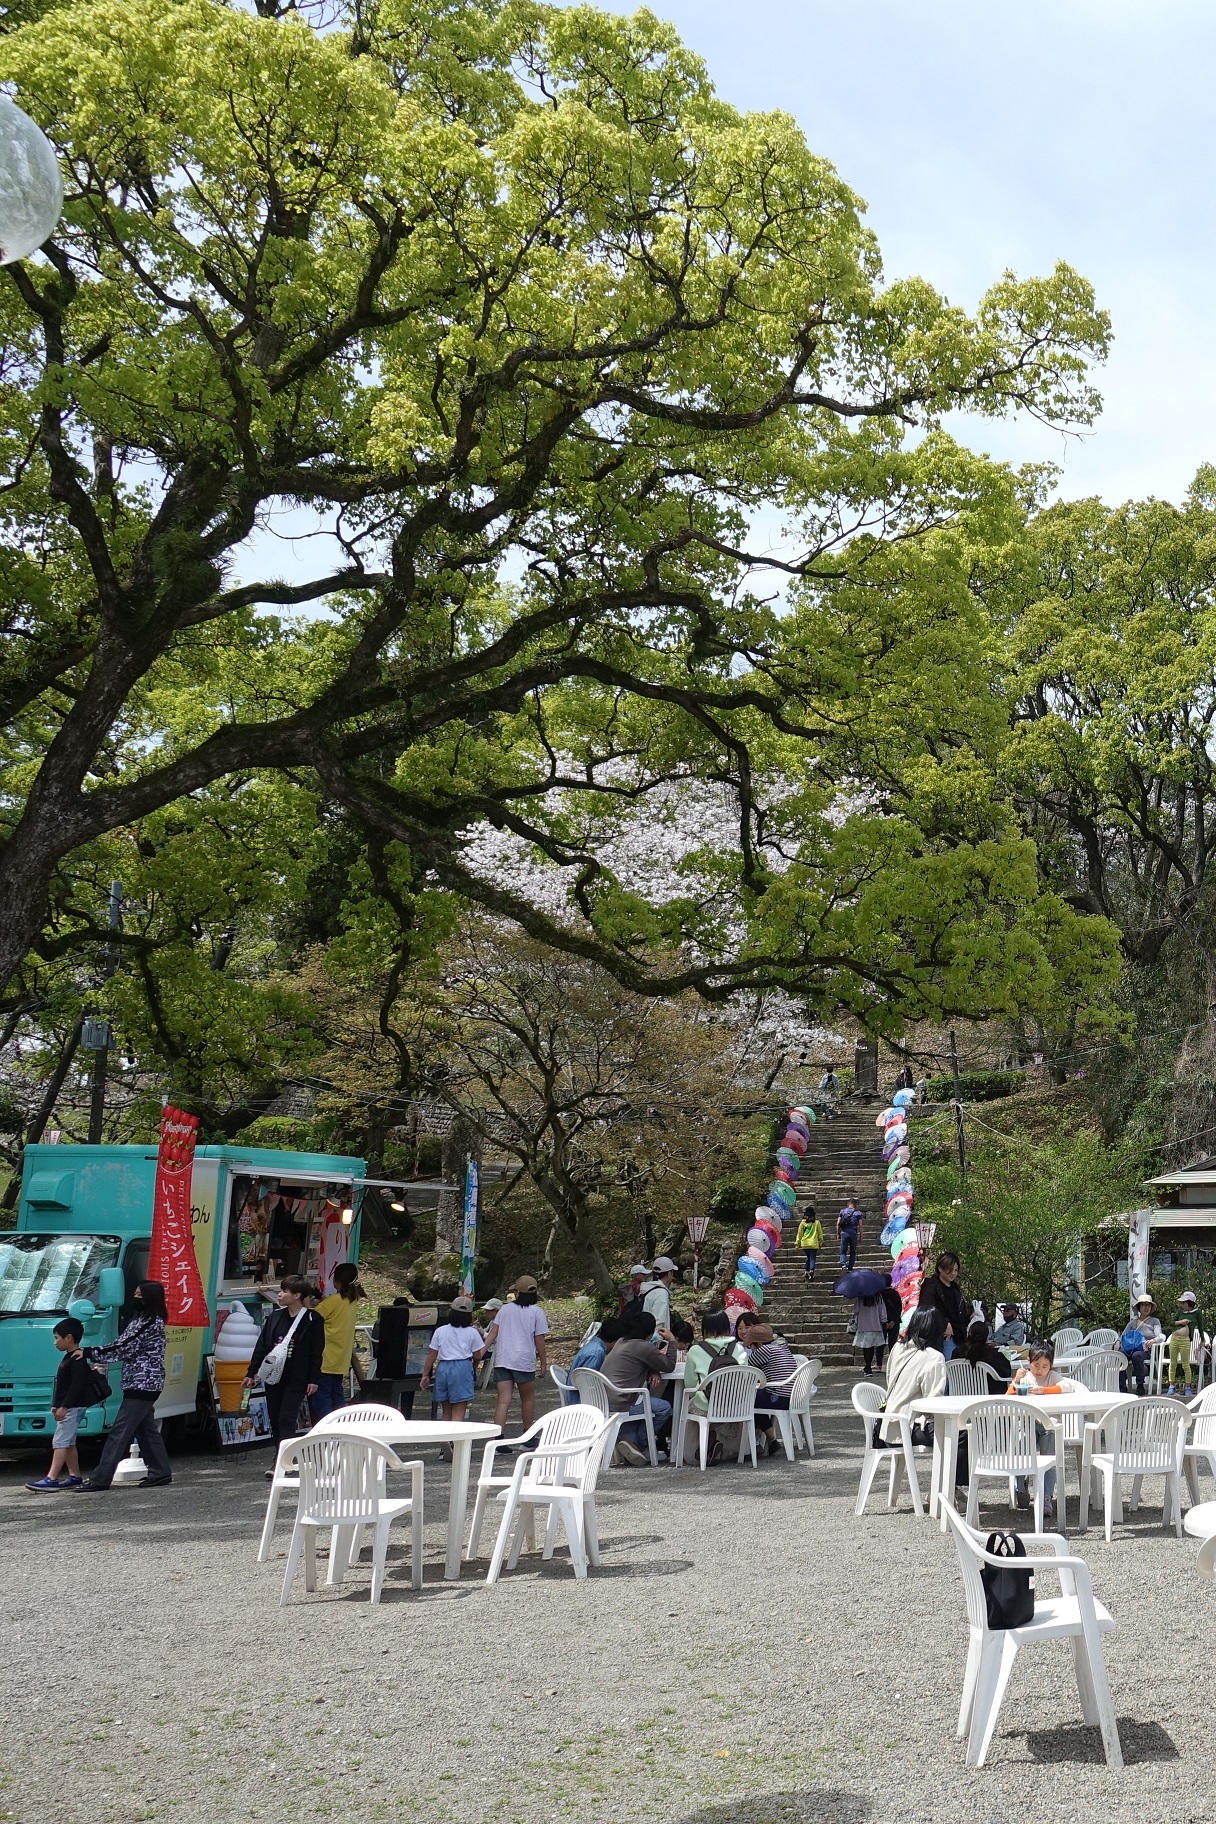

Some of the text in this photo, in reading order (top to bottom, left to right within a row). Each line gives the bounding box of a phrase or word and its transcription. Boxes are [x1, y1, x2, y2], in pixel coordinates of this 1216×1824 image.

[161, 1179, 194, 1314] いちごシェイク
